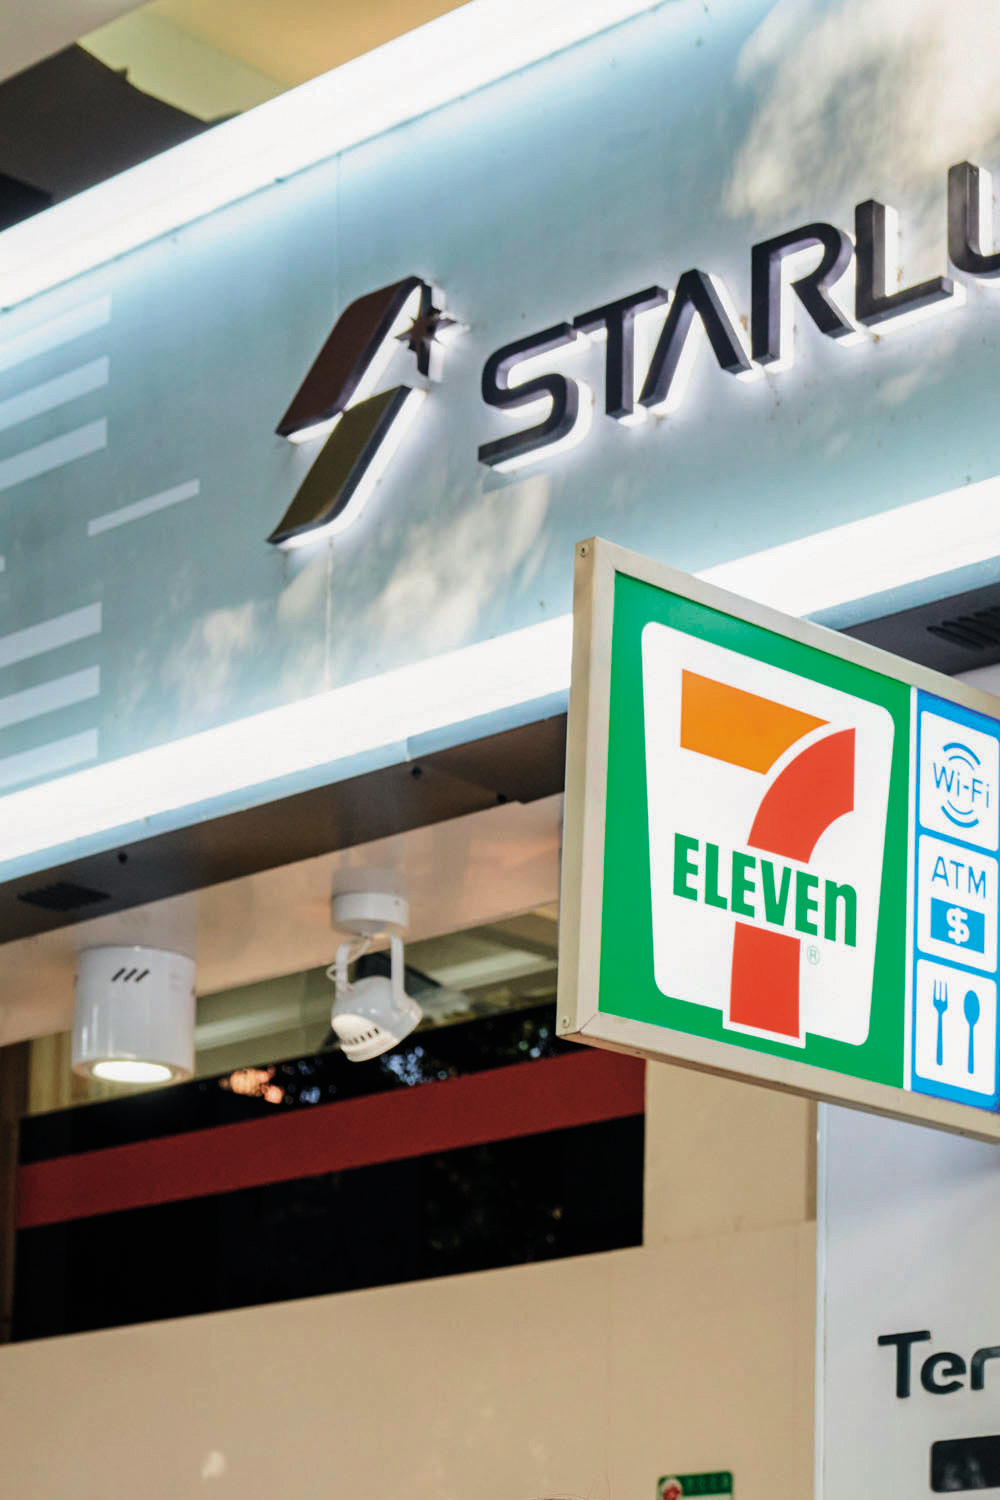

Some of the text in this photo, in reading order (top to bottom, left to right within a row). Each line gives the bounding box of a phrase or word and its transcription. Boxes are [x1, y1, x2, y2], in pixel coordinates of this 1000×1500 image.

[933, 761, 990, 809] Wi-Fi
[680, 668, 856, 1039] 7
[931, 855, 987, 899] ATM
